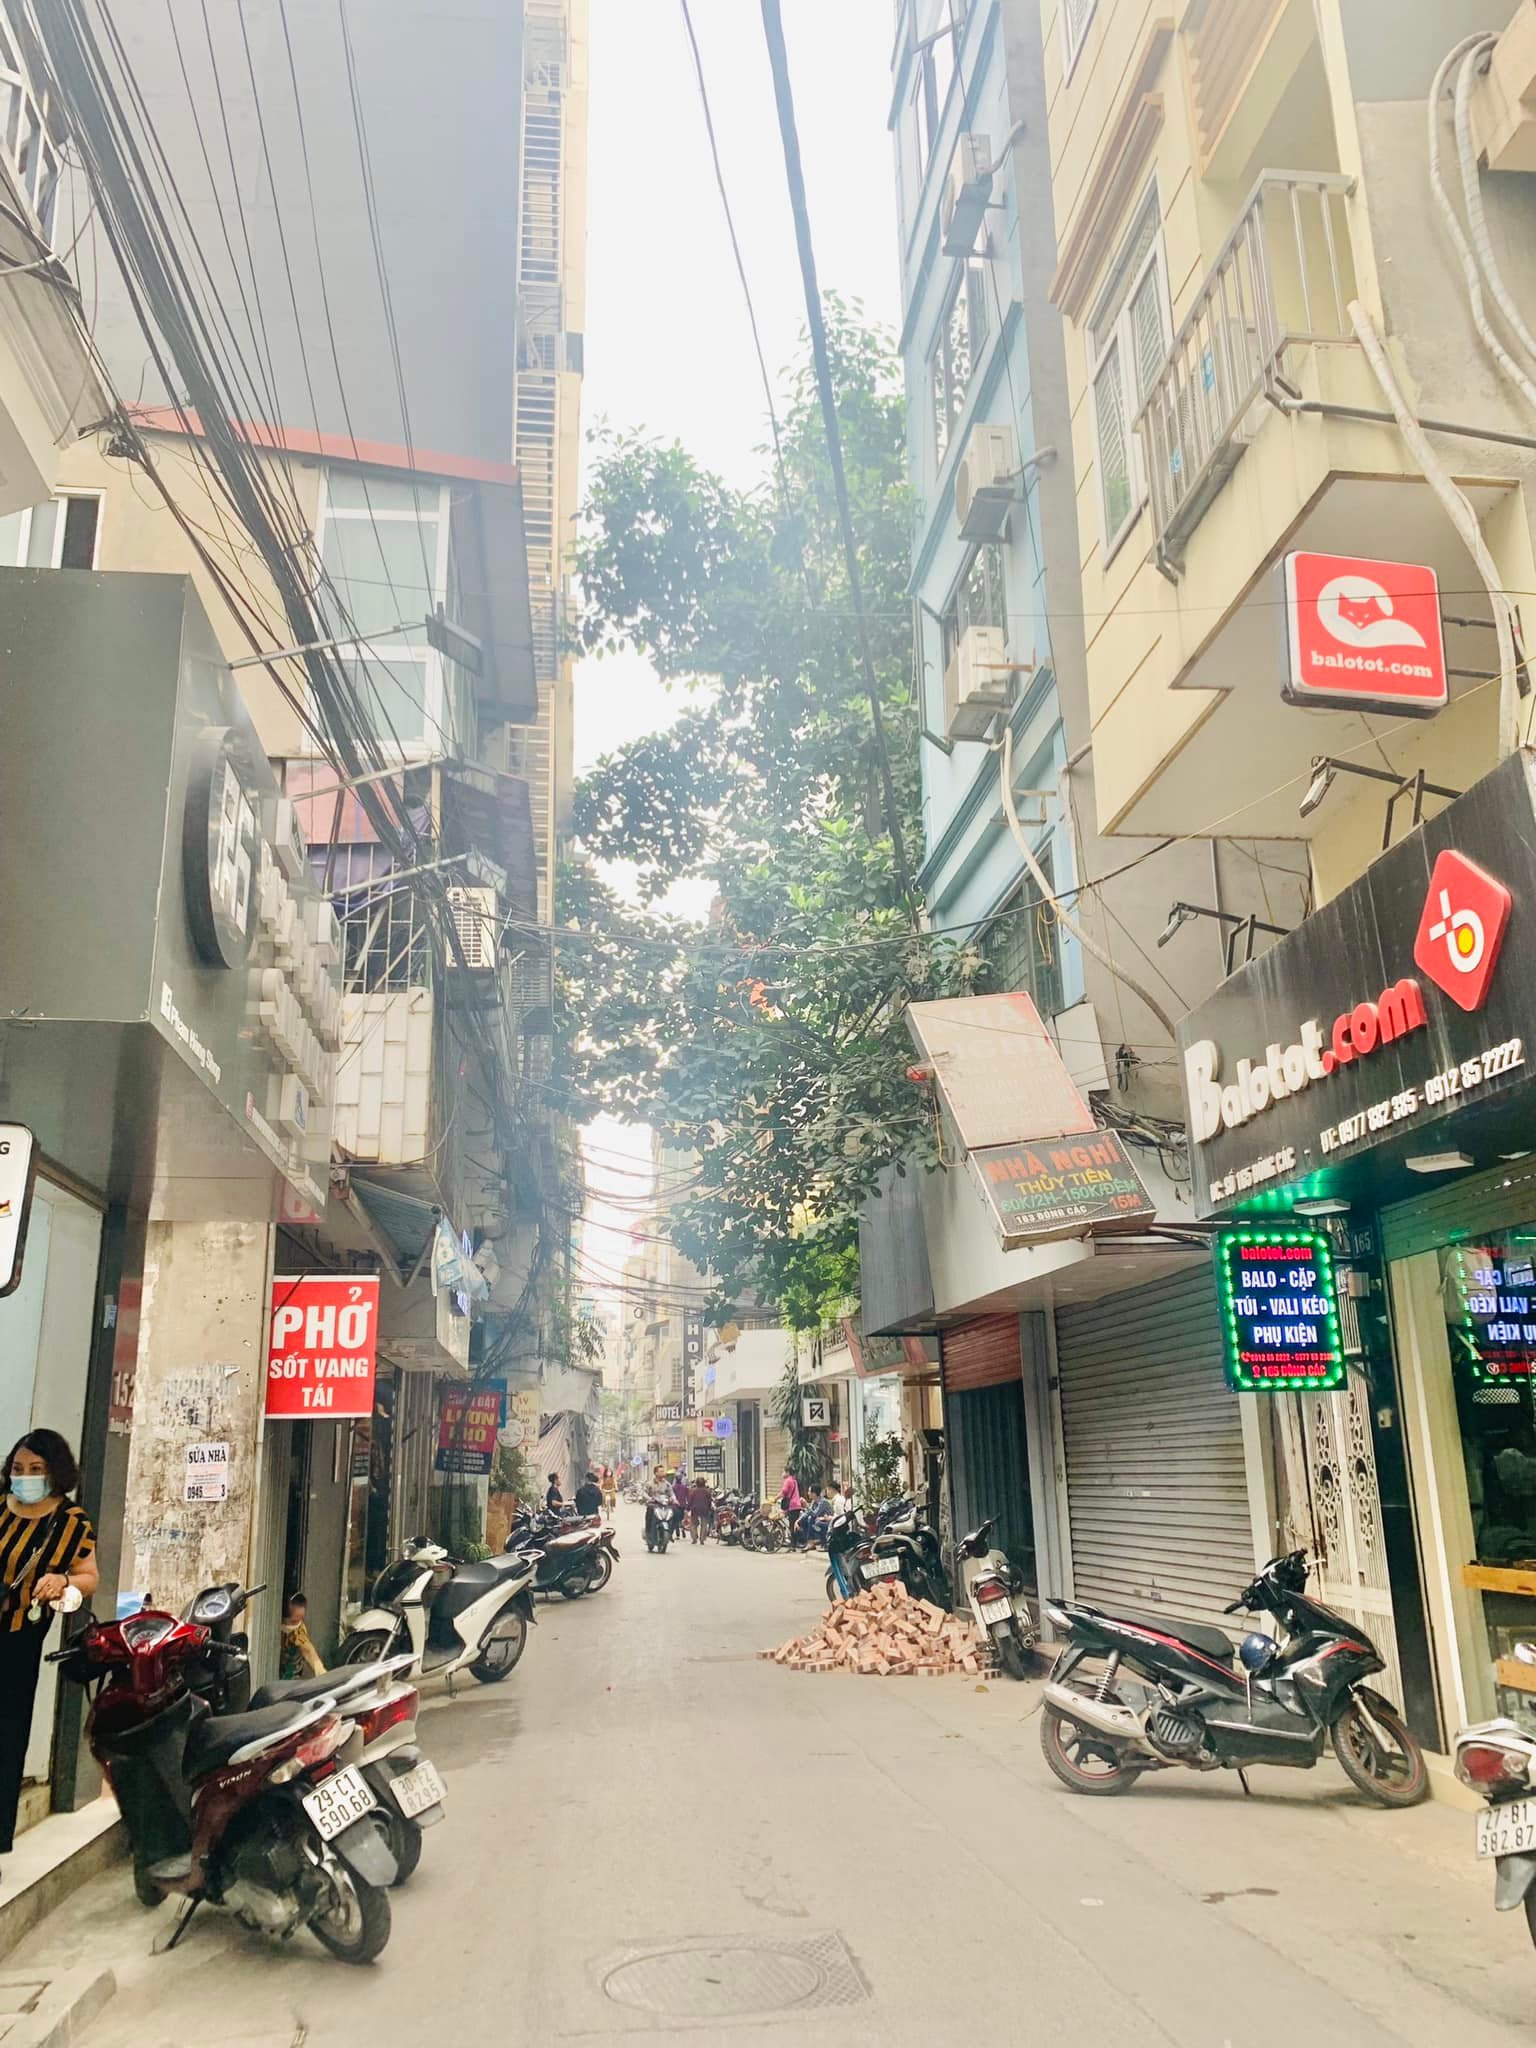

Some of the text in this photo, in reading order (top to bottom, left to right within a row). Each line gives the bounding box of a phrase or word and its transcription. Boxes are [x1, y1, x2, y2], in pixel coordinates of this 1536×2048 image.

[1310, 650, 1433, 678] balotot.com
[1184, 978, 1428, 1144] Balotot.com
[1338, 1116, 1367, 1145] 0977
[1391, 1087, 1419, 1121] 385
[1425, 1067, 1462, 1106] 0912
[1461, 1056, 1484, 1089] 85
[1481, 1038, 1526, 1080] 2222
[986, 1150, 1049, 1184] NHÀ
[1015, 1167, 1113, 1196] THỦY TIÊN
[1066, 1203, 1088, 1218] CÁC
[1353, 1231, 1372, 1255] 165
[1241, 1270, 1277, 1288] BALO
[1289, 1267, 1316, 1291] CẶP
[272, 1286, 373, 1350] PHỞ
[1235, 1295, 1259, 1316] TÚI
[1269, 1298, 1299, 1315] VALI
[1301, 1295, 1329, 1315] KÉO
[1253, 1322, 1318, 1347] PHỤ KIỆN
[269, 1351, 369, 1379] SỐT VANG
[1307, 1362, 1326, 1377] CÁC
[301, 1383, 334, 1407] TÁI
[656, 1405, 682, 1420] HOTEL
[188, 1446, 206, 1464] SỬA
[313, 1773, 358, 1814] 29-C1
[319, 1789, 372, 1835] 590.68
[1485, 1802, 1529, 1831] 27-B1
[1480, 1825, 1535, 1855] 382.87
